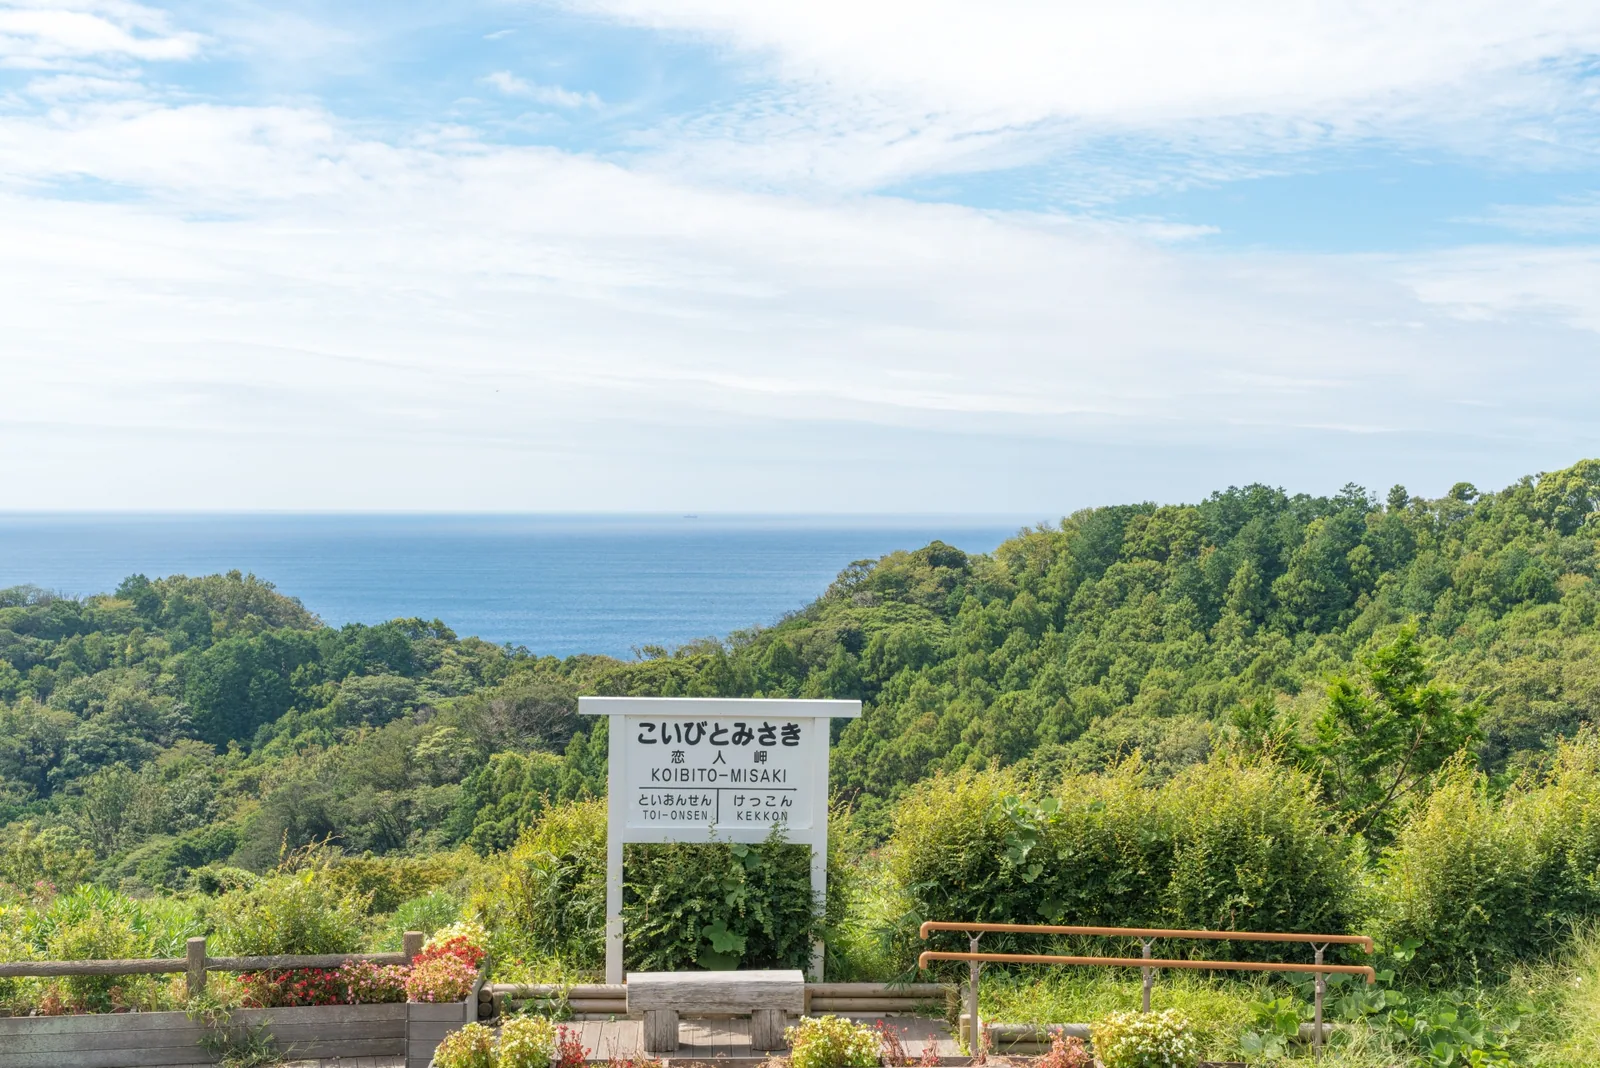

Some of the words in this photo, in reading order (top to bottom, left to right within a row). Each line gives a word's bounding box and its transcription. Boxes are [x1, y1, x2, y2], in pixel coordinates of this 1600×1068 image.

[637, 720, 802, 747] こいびとみさき
[670, 749, 768, 765] 恋人岬
[651, 767, 787, 783] KOIBITO-MISAKI
[638, 793, 712, 807] といおんせん
[733, 794, 793, 808] けっこん
[642, 809, 708, 821] TOI-ONSEN
[736, 810, 788, 822] KEKKON
